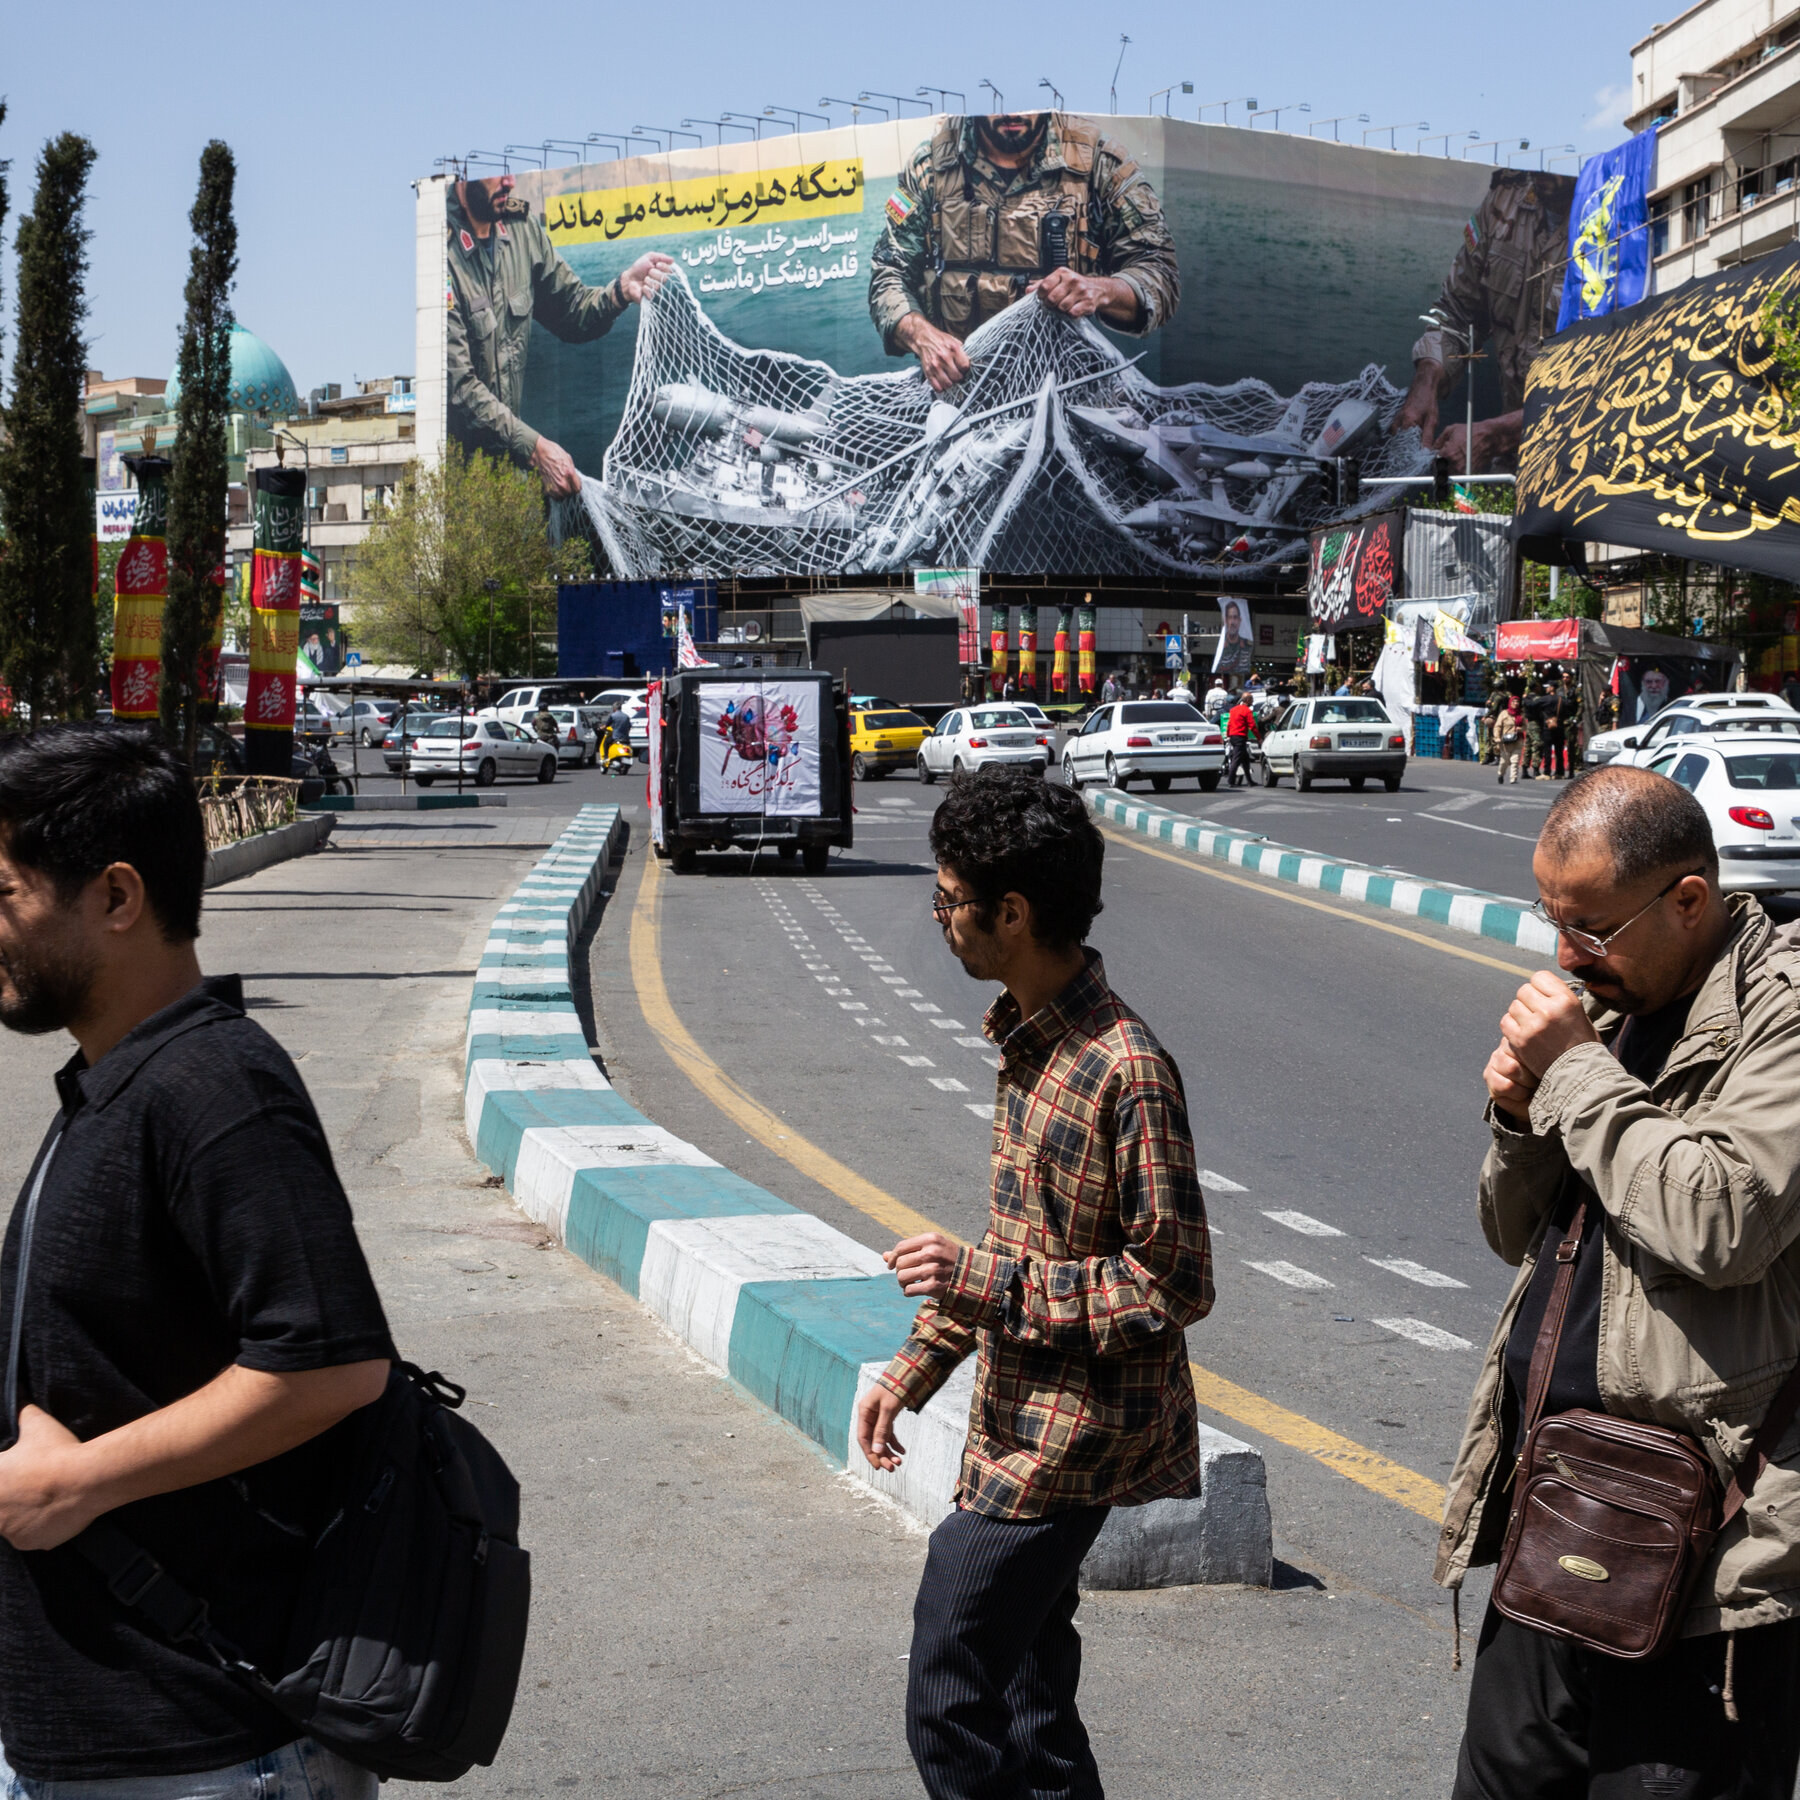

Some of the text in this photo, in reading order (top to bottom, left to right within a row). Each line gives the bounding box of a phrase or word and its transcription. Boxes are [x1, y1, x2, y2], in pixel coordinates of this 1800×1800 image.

[790, 162, 857, 201] تنگه
[649, 191, 717, 223] بسته
[714, 178, 787, 226] هرمز
[786, 222, 859, 256] سراسر
